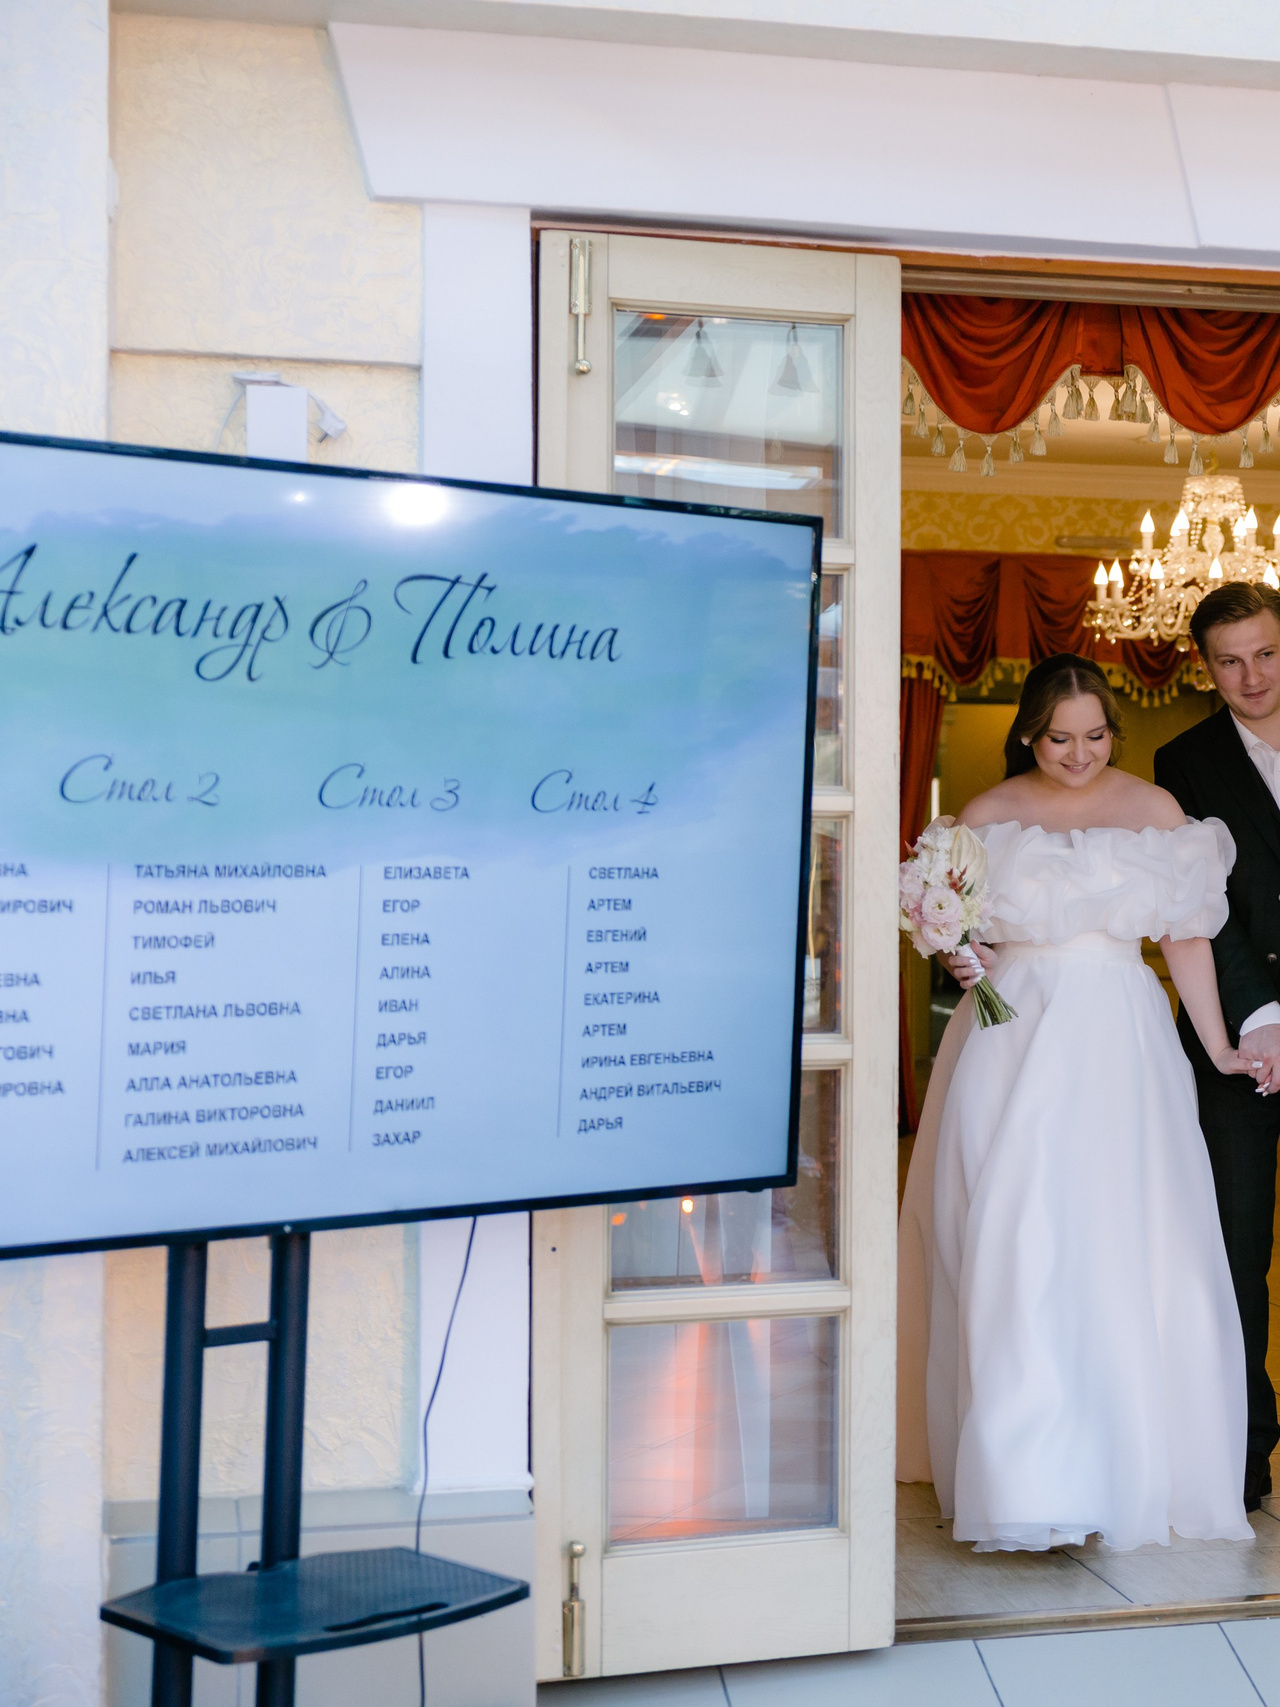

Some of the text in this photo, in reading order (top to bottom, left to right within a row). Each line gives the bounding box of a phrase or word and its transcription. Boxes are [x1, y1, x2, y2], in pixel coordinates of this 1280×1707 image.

[0, 543, 289, 682] Александр
[394, 572, 620, 665] Полина
[59, 755, 220, 807] Стол 2
[317, 763, 460, 812] Стол 3
[531, 769, 620, 814] Стол
[0, 863, 28, 877] НА
[134, 862, 327, 879] ТАТЬЯНА МИХАЙЛОВНА
[384, 867, 470, 880] ЕЛИЗАВЕТА
[588, 867, 659, 880] СВЕТЛАНА
[133, 899, 277, 915] РОМАН ЛЬВОВИЧ
[382, 899, 420, 913] ЕГОР
[587, 898, 632, 911] АРТЕМ
[133, 932, 215, 949] ТИМОФЕЙ
[381, 933, 430, 946] ЕЛЕНА
[586, 927, 647, 943] ЕВГЕНИЙ
[379, 966, 431, 980] АЛИНА
[585, 961, 630, 974] АРТЕМ
[130, 971, 176, 985] ИЛЬЯ
[378, 999, 419, 1013] ИВАН
[583, 991, 660, 1006] ЕКАТЕРИНА
[129, 1001, 302, 1022] СВЕТЛАНА ЛЬВОВНА
[582, 1023, 627, 1037] АРТЕМ
[128, 1040, 187, 1056] МАРИЯ
[376, 1032, 427, 1048] ДАРЬЯ
[581, 1050, 714, 1069] ИРИНА ЕВГЕНЬЕВНА
[375, 1065, 414, 1080] ЕГОР
[0, 1080, 65, 1097] РОВНА
[125, 1070, 298, 1092] АЛЛА АНАТОЛЬЕВНА
[579, 1080, 721, 1101] АНДРЕЙ ВИТАЛЬЕВИЧ
[373, 1096, 435, 1115] ДАНИИЛ
[125, 1104, 305, 1127] ГАЛИНА ВИКТОРОВНА
[577, 1117, 623, 1134] ДАРЬЯ
[372, 1131, 421, 1147] ЗАХАР
[123, 1137, 318, 1163] АЛЕКСЕЙ МИХАЙЛОВИЧ
